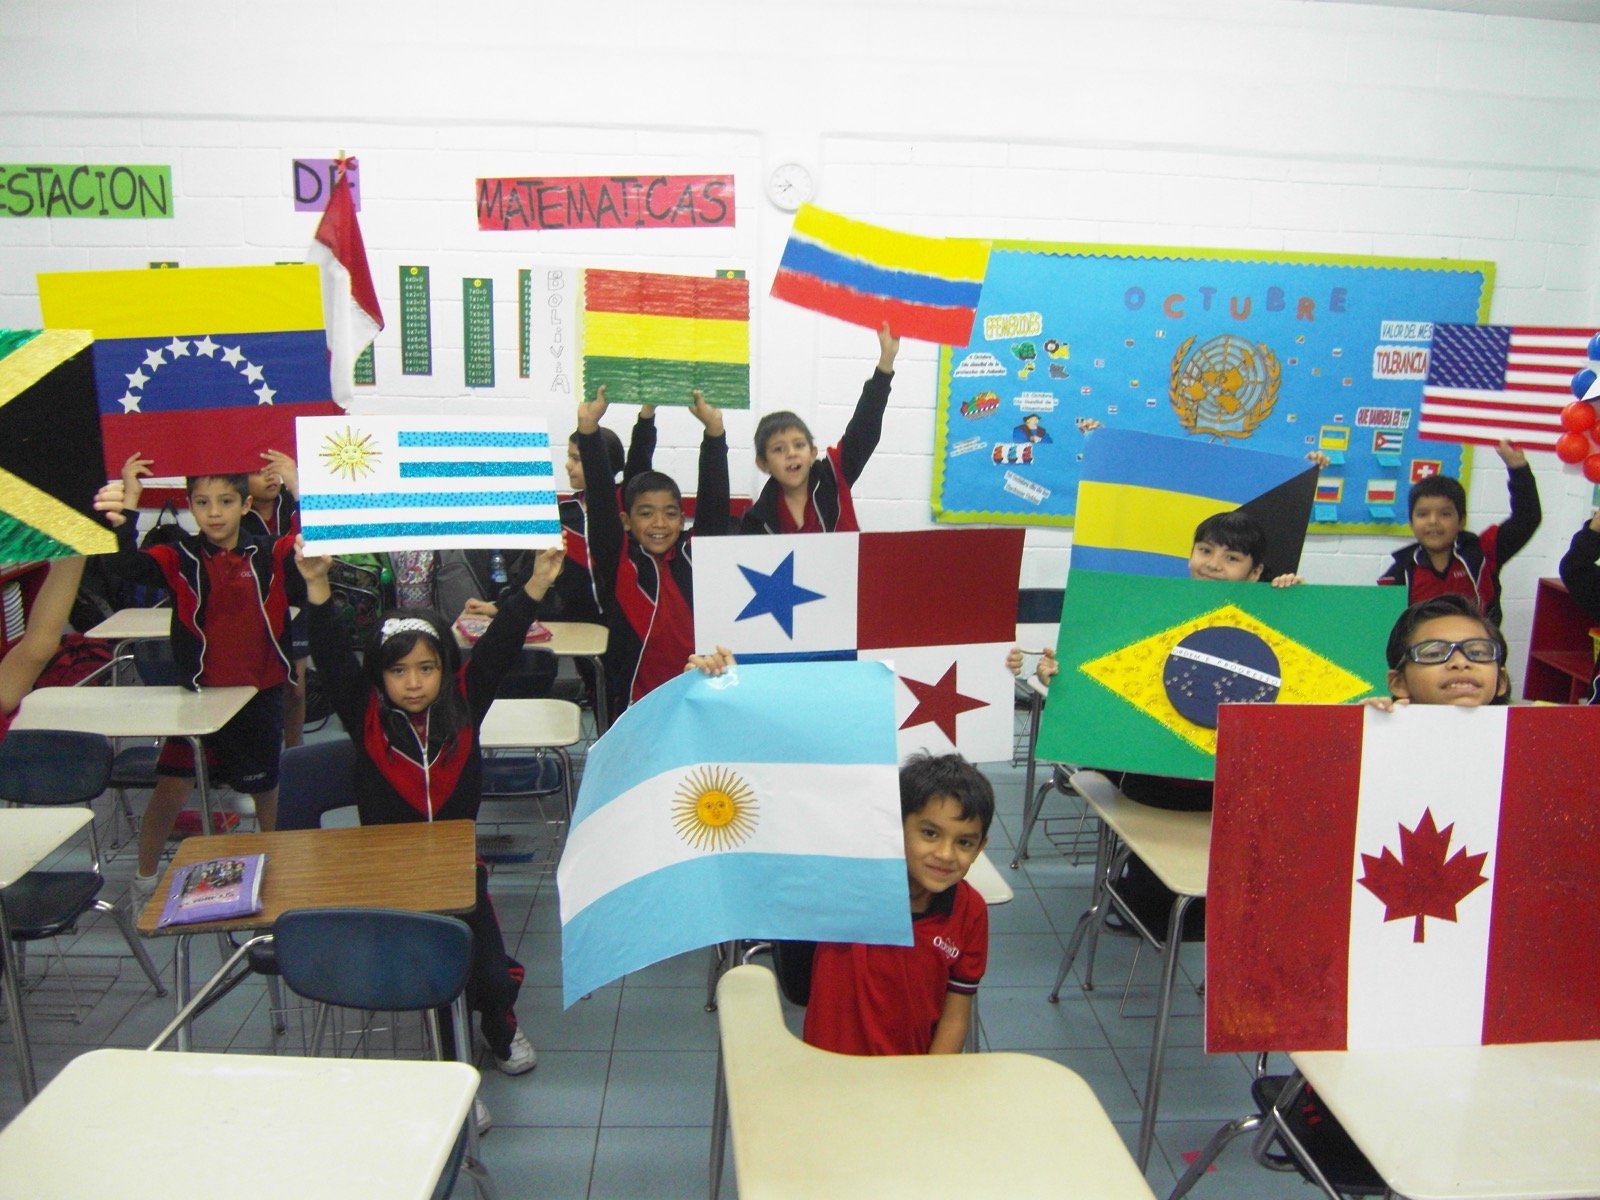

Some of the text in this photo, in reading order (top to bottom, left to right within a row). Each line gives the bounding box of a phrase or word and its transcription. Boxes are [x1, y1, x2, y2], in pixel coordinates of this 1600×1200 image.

[477, 176, 727, 231] MATEMATICAS
[1124, 286, 1348, 321] OCTUBRE
[1382, 323, 1433, 339] VALOR DEL MES
[1376, 350, 1427, 375] TOLERANCIA
[1172, 648, 1201, 660] ORDEM
[1217, 660, 1279, 685] PROGRESSO
